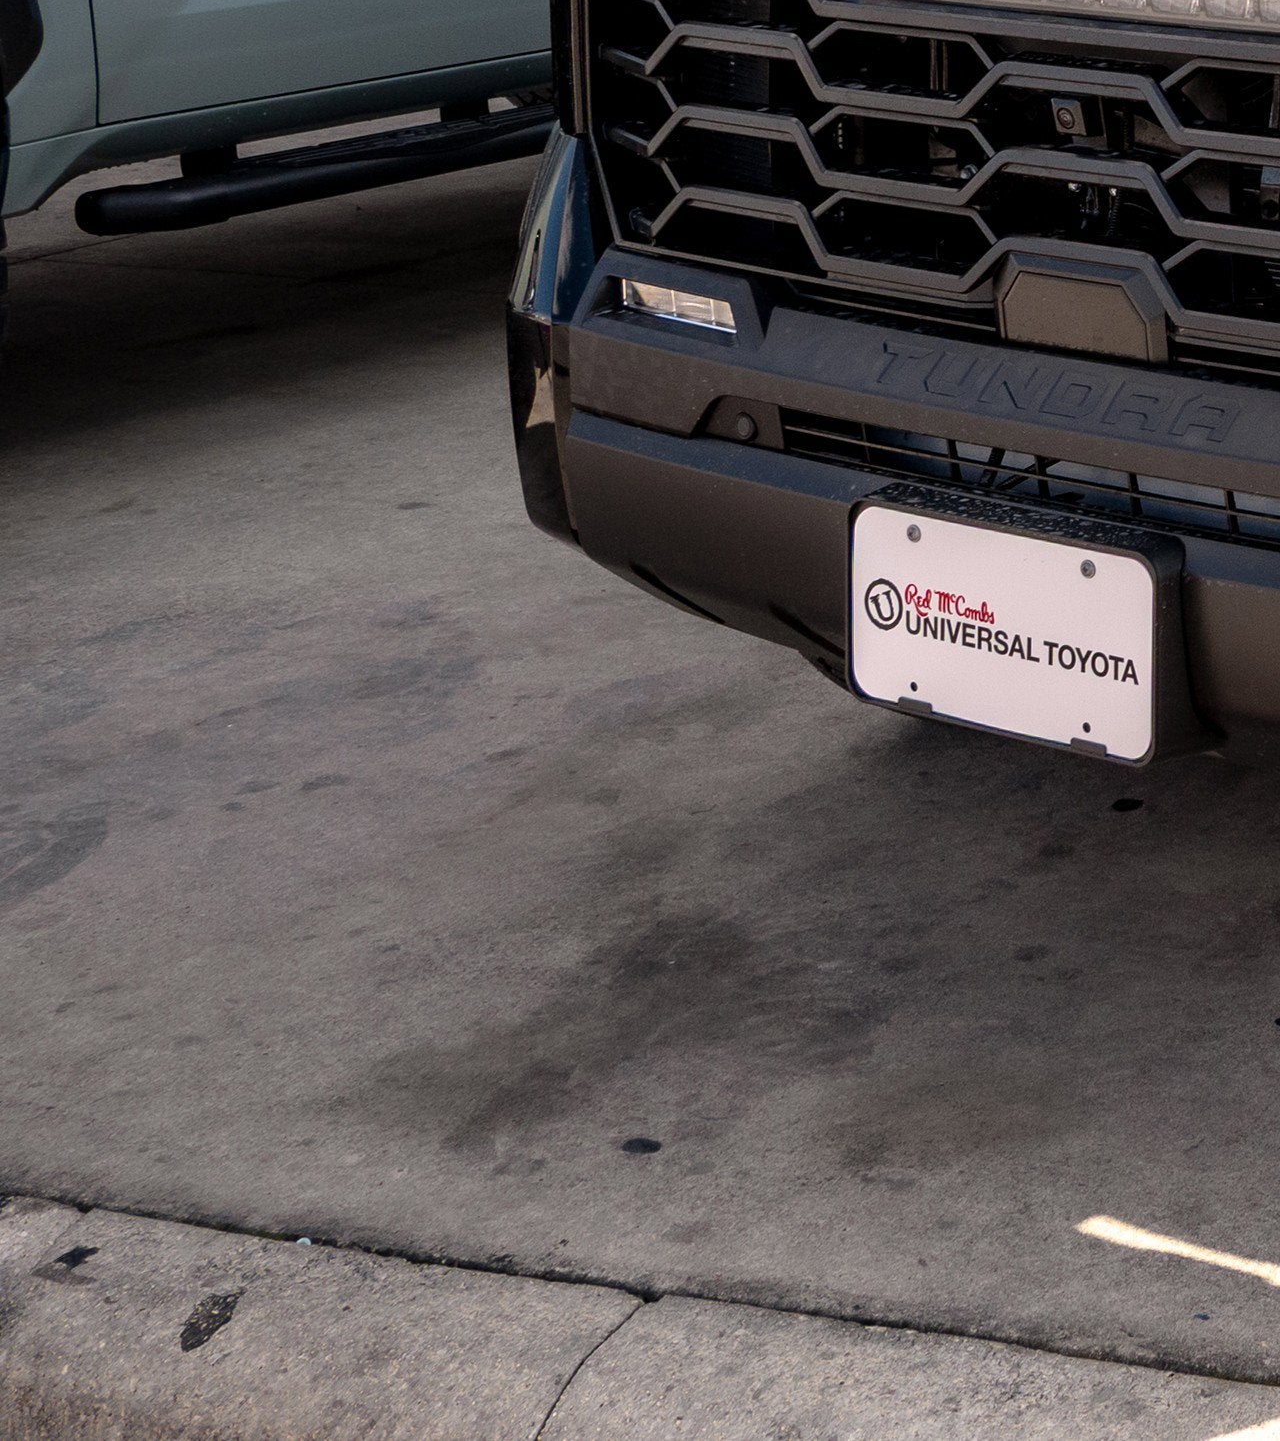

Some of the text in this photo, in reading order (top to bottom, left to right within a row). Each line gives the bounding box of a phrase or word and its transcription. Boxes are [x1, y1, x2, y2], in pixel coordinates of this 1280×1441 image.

[876, 341, 1243, 443] TUNDRA
[904, 583, 996, 625] Red McCombs
[905, 611, 1140, 686] UNIVERSAL TOYOTA
